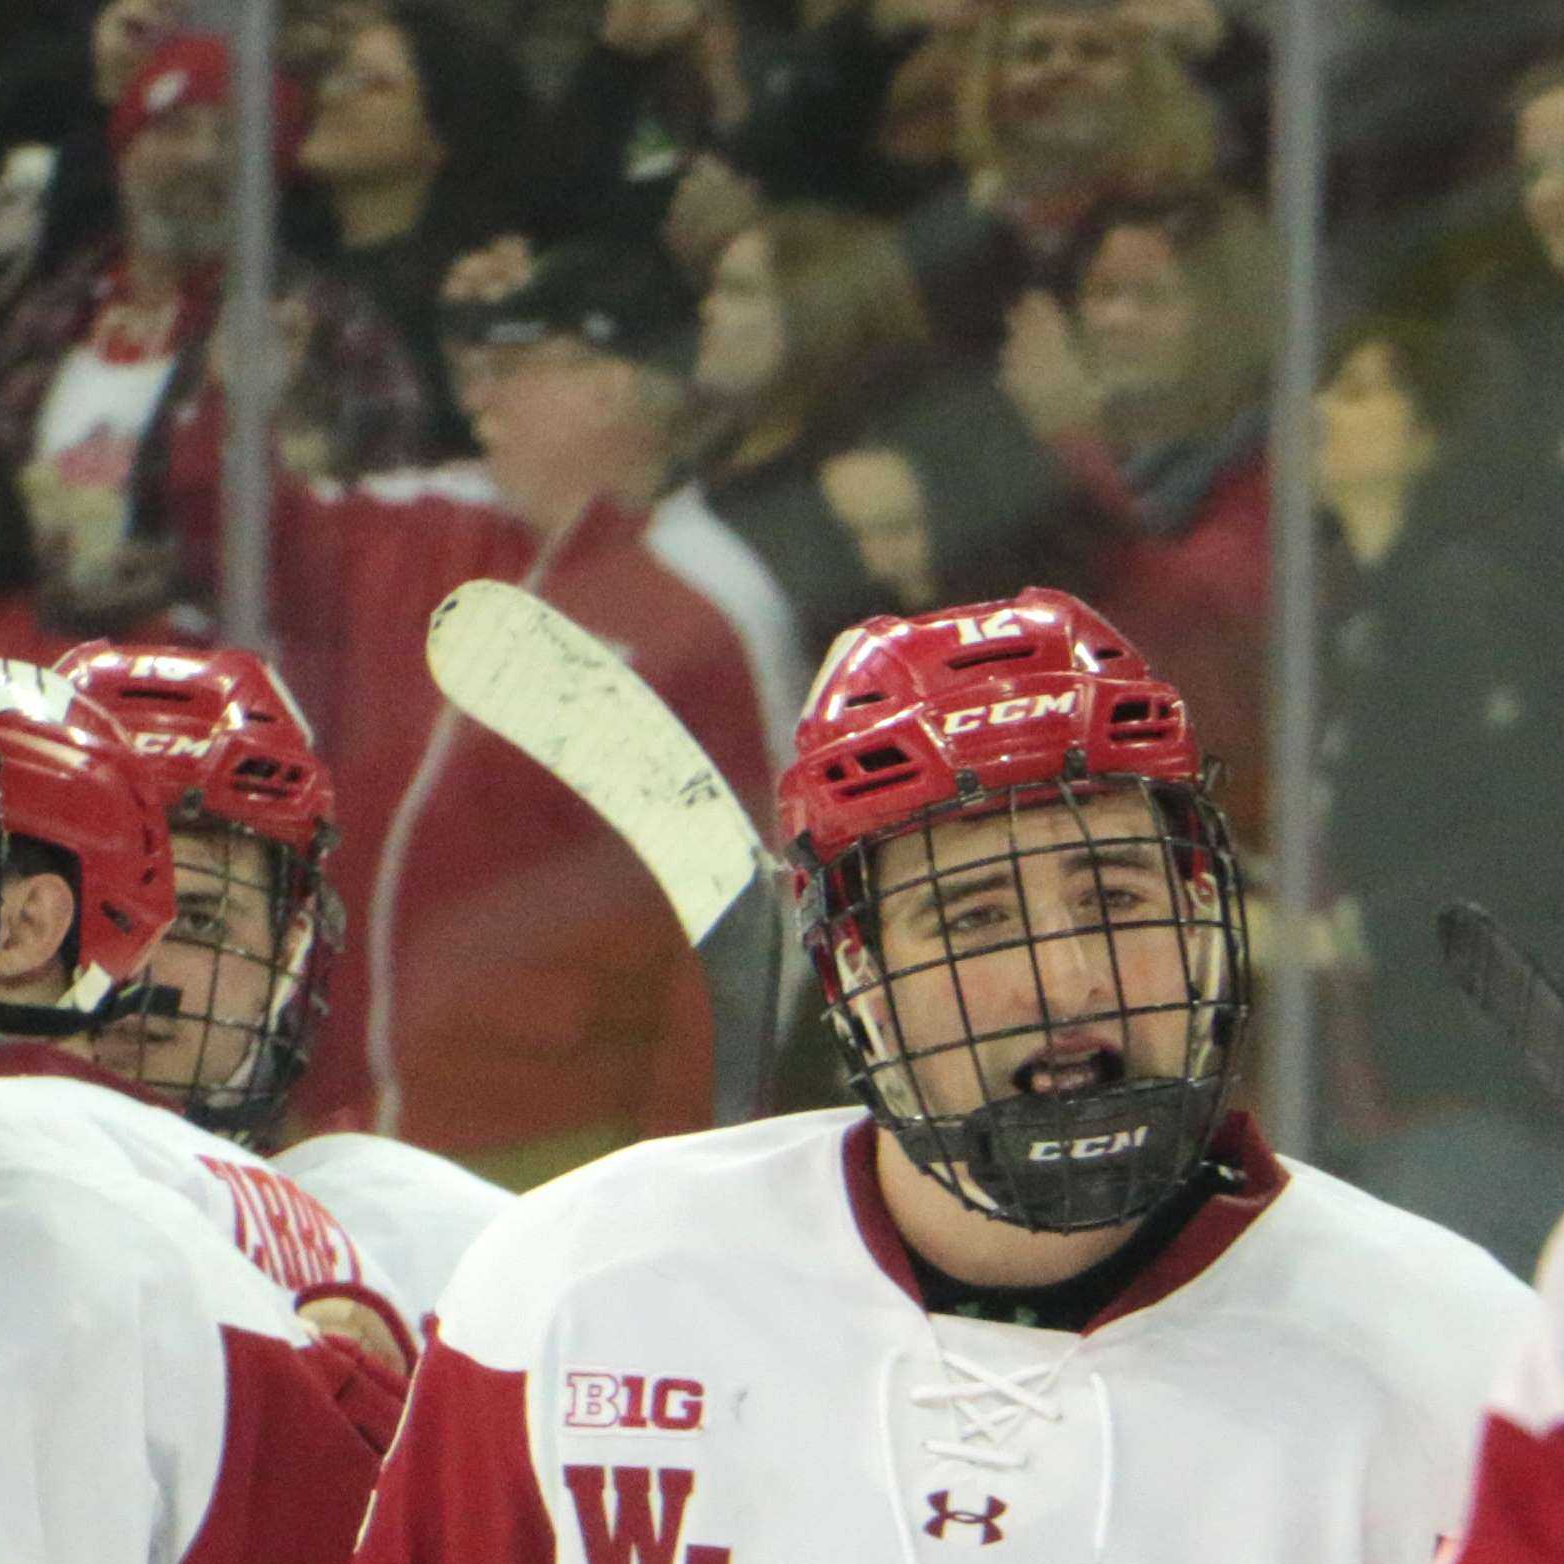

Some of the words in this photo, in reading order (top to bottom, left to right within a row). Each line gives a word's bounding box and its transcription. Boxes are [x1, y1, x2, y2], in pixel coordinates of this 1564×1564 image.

[956, 607, 1024, 647] 12
[942, 690, 1078, 737] CCM
[132, 731, 214, 759] CM
[1028, 1125, 1151, 1162] CCM
